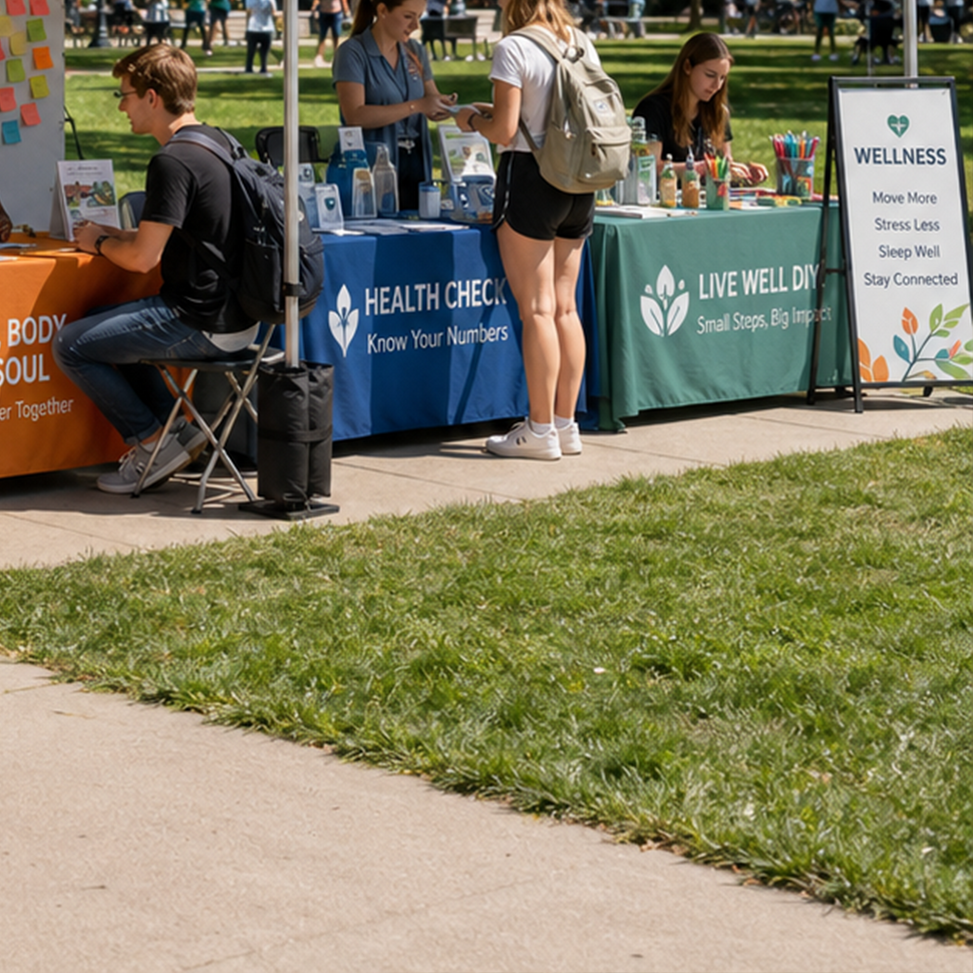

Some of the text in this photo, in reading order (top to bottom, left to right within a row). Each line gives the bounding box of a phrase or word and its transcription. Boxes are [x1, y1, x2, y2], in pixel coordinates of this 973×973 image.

[853, 147, 948, 166] WELLNESS
[872, 191, 938, 205] Move More
[874, 217, 941, 232] Stress Less
[878, 244, 941, 261] Sleep Well
[699, 270, 739, 301] LIVE
[741, 266, 789, 296] WELL
[863, 272, 959, 289] Stay Connected
[365, 277, 508, 317] HEALTH CHECK
[7, 313, 68, 348] BODY
[696, 312, 731, 335] Small
[732, 311, 769, 333] Steps,
[770, 307, 790, 330] Big
[367, 322, 509, 355] Know Your Numbers
[15, 397, 75, 422] Together
